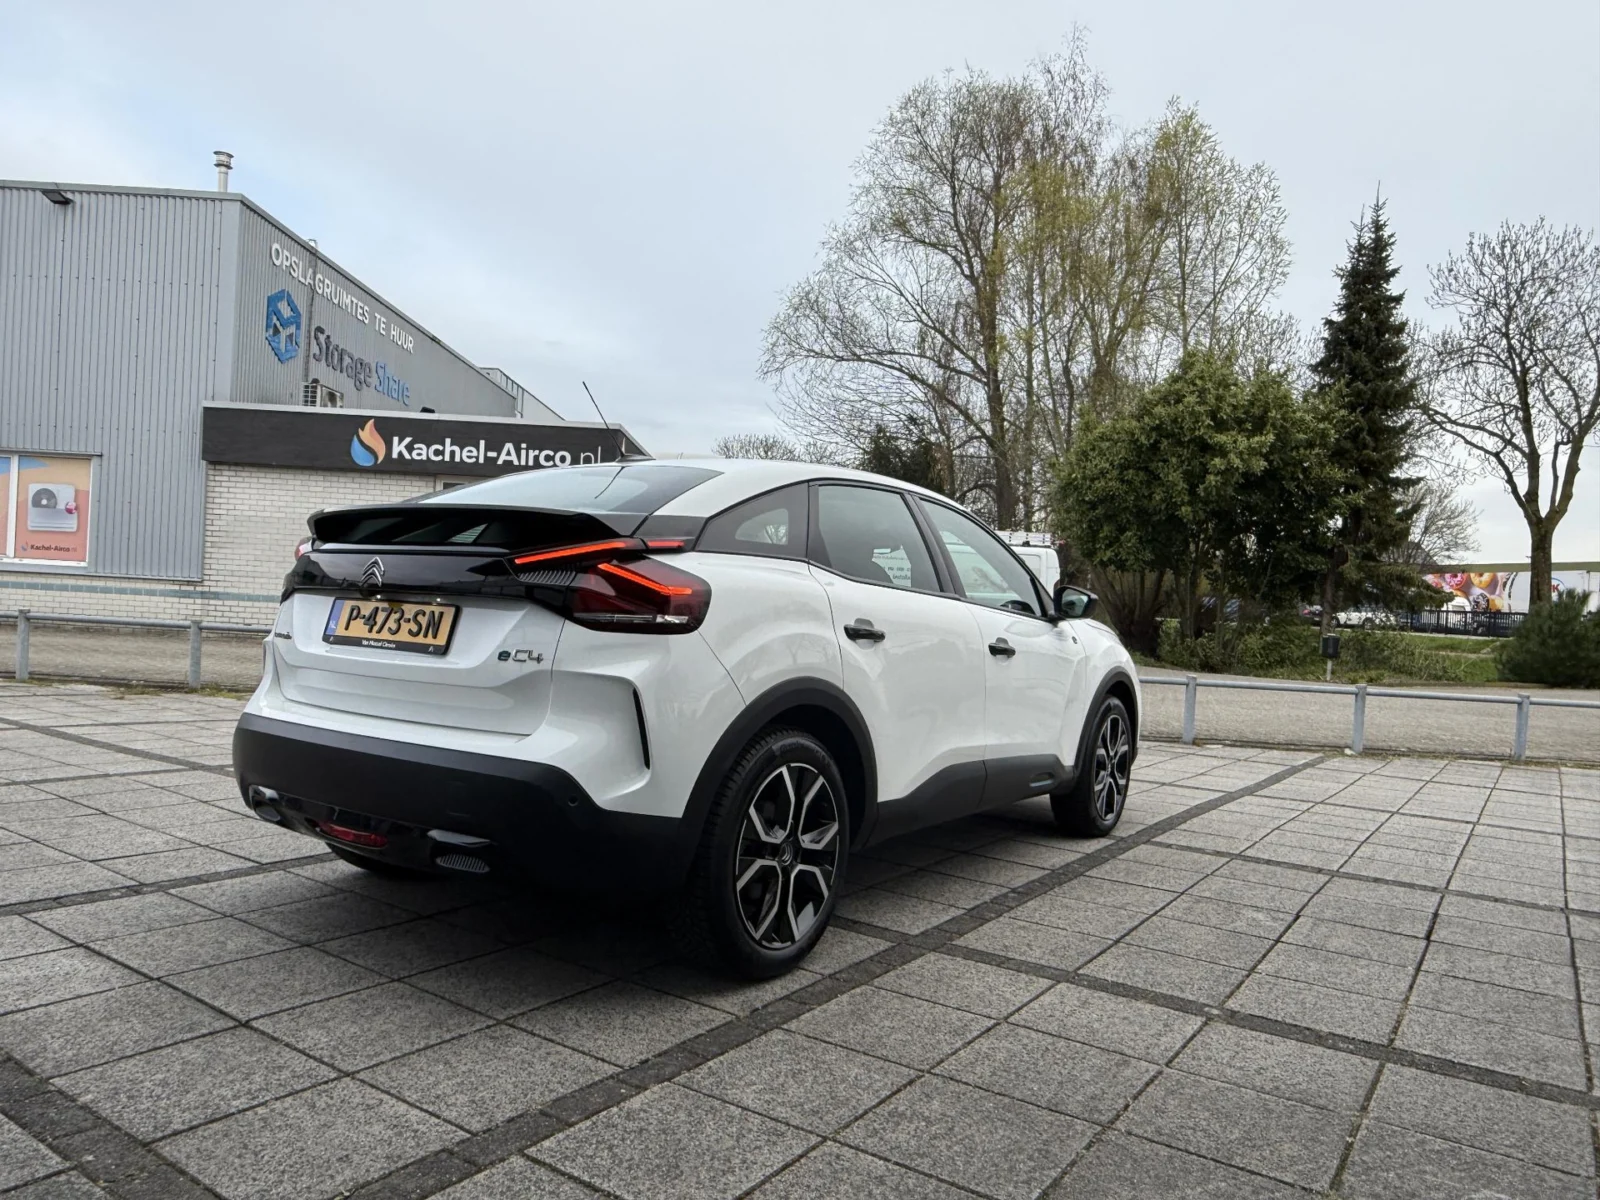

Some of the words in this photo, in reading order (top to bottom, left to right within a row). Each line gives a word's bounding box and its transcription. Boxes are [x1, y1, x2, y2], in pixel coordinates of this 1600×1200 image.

[375, 312, 386, 336] TE
[390, 325, 415, 354] HUUR
[313, 325, 373, 391] Storage
[374, 361, 410, 407] Share
[344, 604, 444, 640] P-473-SN
